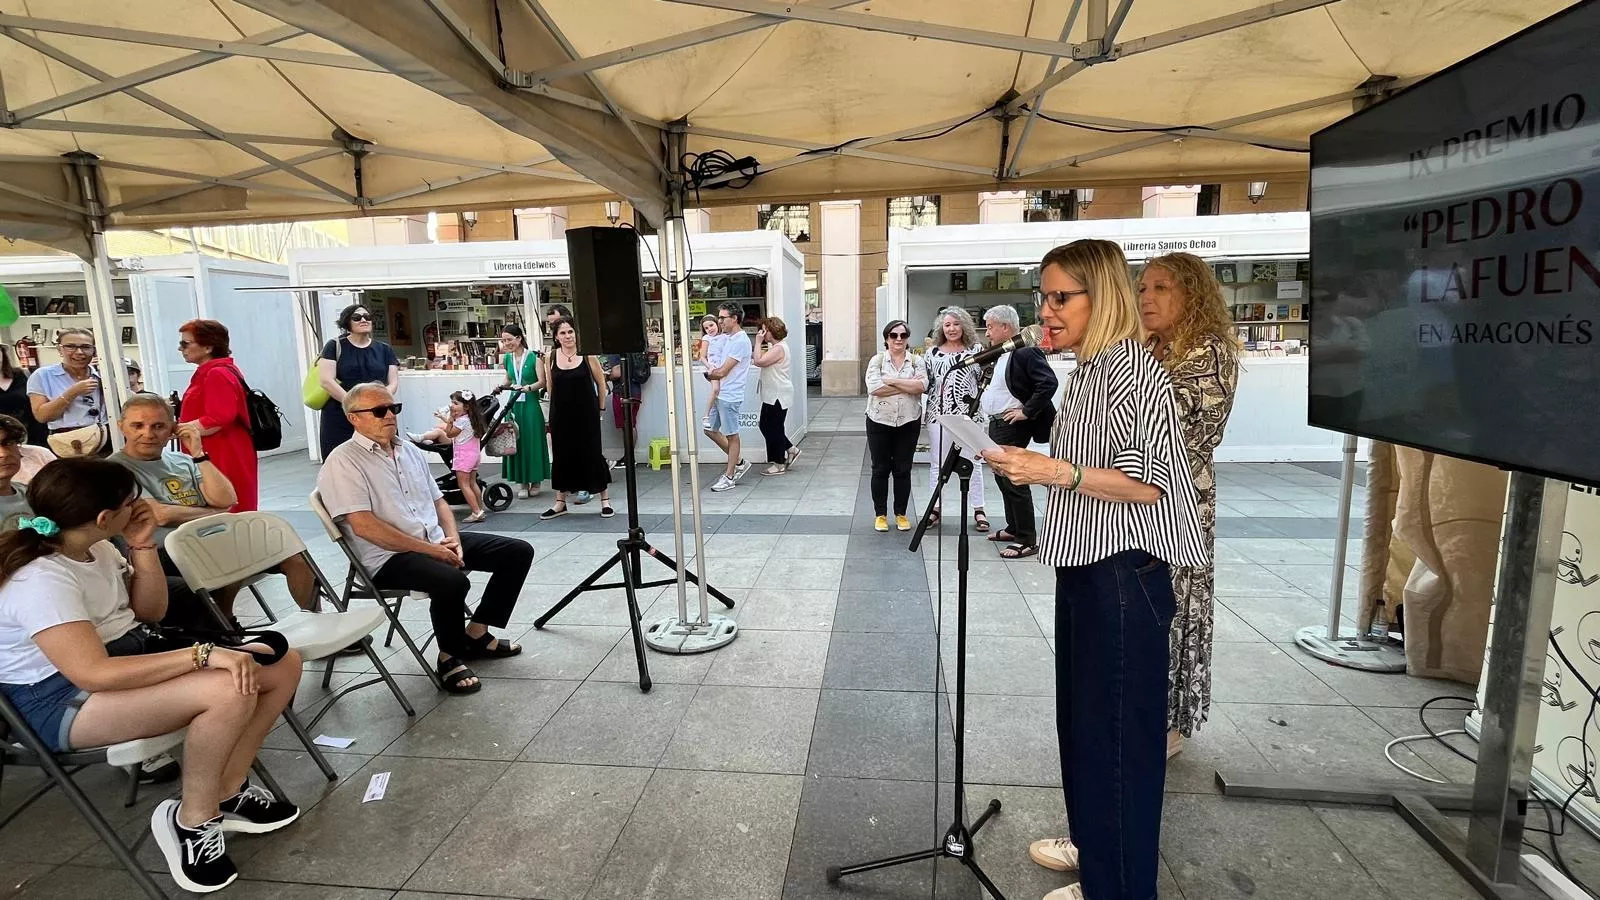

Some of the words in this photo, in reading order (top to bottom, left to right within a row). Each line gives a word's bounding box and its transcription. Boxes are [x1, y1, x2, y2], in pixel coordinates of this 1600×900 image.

[1408, 146, 1435, 179] IX
[1442, 93, 1586, 170] PREMIO
[1158, 241, 1187, 250] Santos
[1189, 240, 1217, 249] Ochoa
[1418, 323, 1443, 344] EN
[1450, 314, 1593, 345] ARAGONÉS
